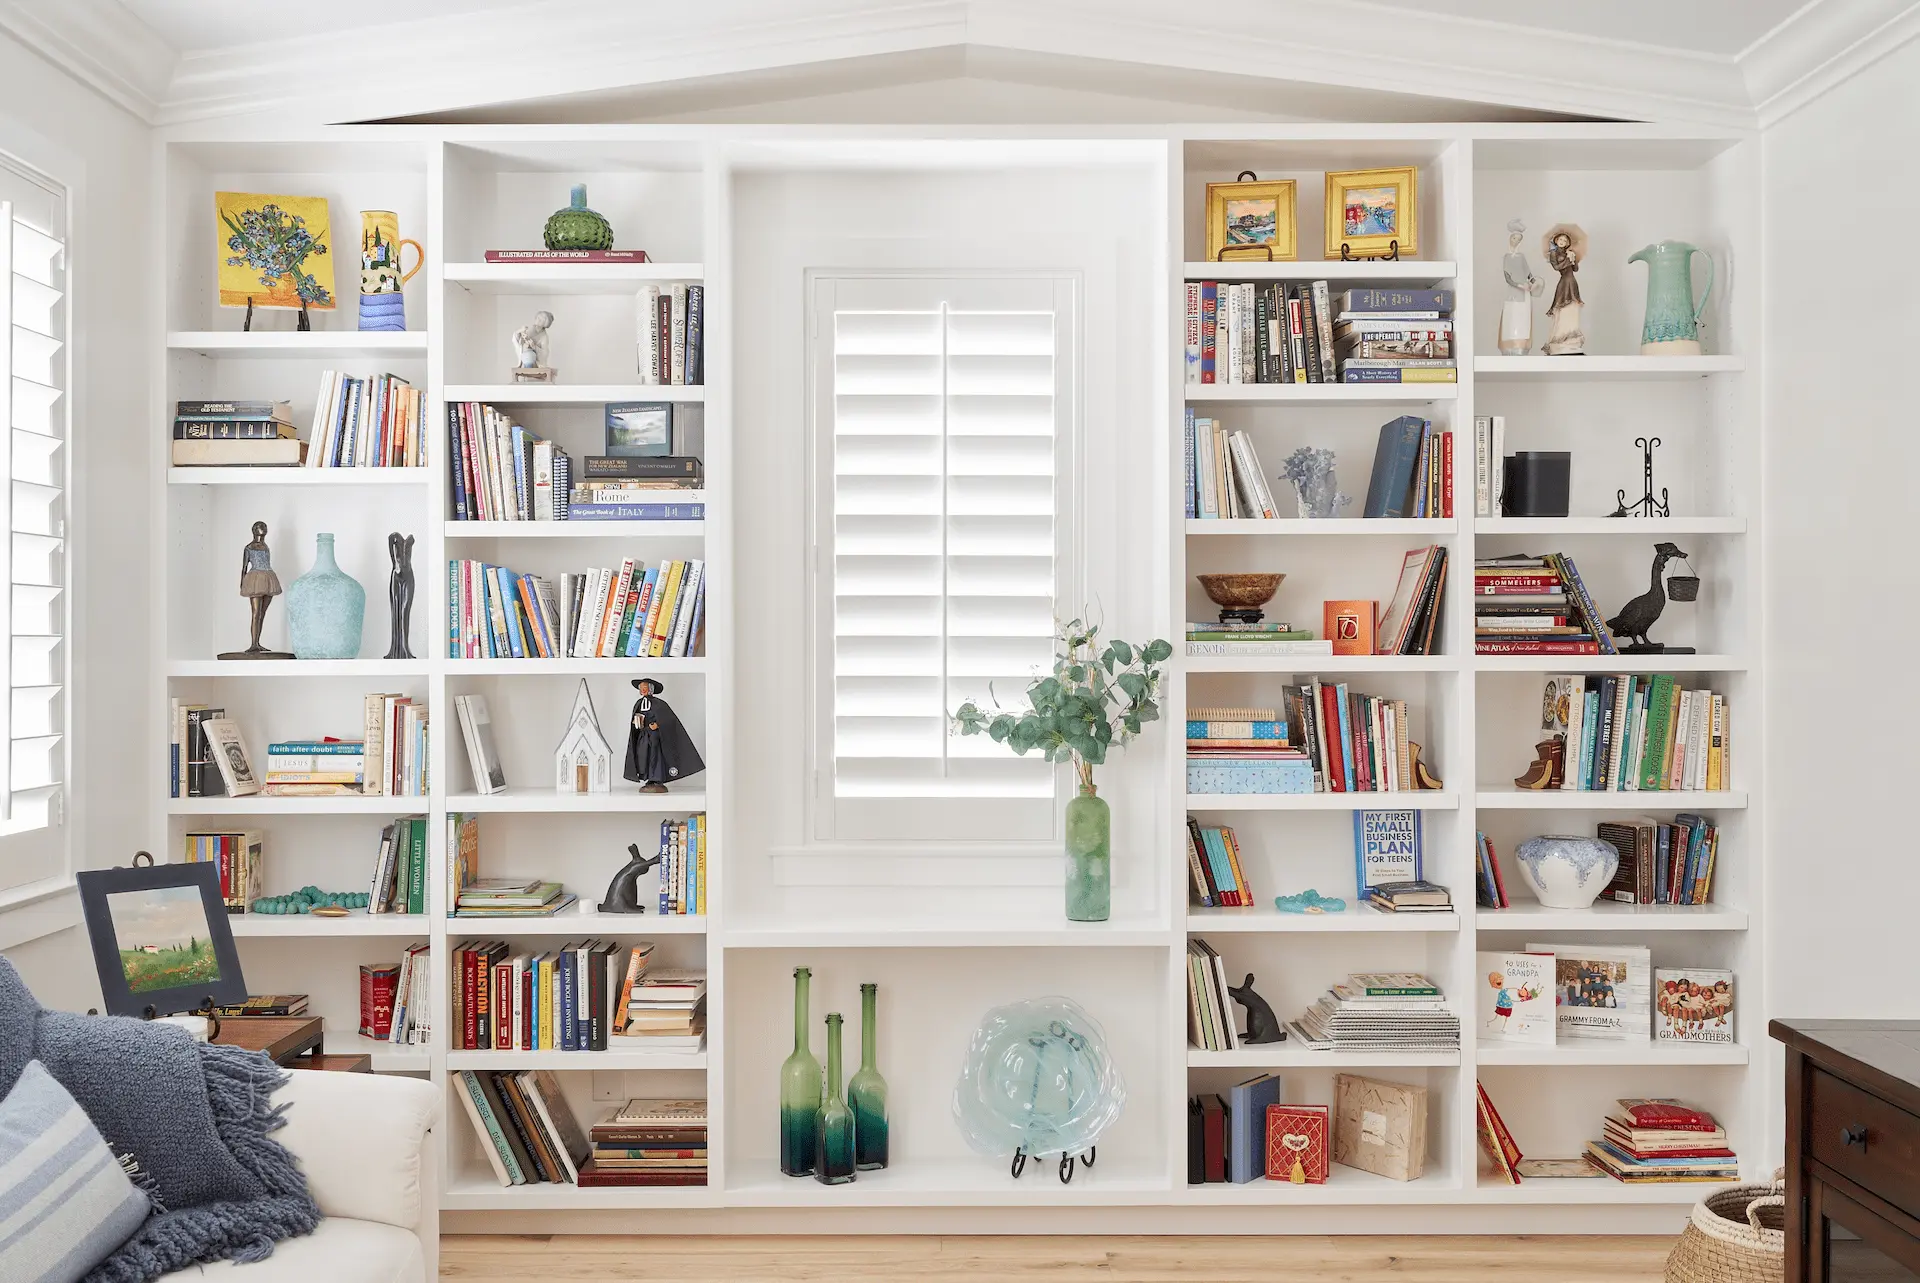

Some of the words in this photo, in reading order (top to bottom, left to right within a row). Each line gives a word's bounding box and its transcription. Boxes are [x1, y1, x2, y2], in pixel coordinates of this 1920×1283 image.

[692, 287, 701, 312] HARPER
[1207, 300, 1215, 317] TOM
[690, 313, 699, 324] LEE
[1258, 304, 1266, 331] EMERALD
[1207, 319, 1215, 353] BROKAW
[1322, 322, 1331, 360] TRANSITIONS
[469, 439, 479, 473] LONDON
[595, 490, 629, 502] Rome
[617, 507, 644, 516] ITALY
[623, 564, 632, 574] THE
[450, 569, 458, 604] DREAMS
[599, 570, 609, 596] GETTING
[618, 574, 630, 596] CAPTAIN
[596, 596, 605, 611] PAST
[615, 596, 625, 614] CLASS
[640, 584, 652, 612] SWITCH
[595, 612, 602, 621] NO
[647, 594, 661, 626] LIMITLESS
[1581, 592, 1592, 610] SCIENCE
[1592, 616, 1605, 636] WINE
[642, 628, 652, 645] MIND
[1190, 644, 1225, 654] RENOIR
[1511, 643, 1516, 652] of
[1661, 679, 1672, 690] the
[1658, 692, 1669, 717] world's
[1572, 703, 1580, 741] OTTOLENGHI
[1604, 710, 1612, 723] MILK
[1691, 705, 1700, 735] DEFINED
[1602, 724, 1611, 745] STREET
[1653, 719, 1667, 752] healthiest
[272, 745, 290, 753] faith
[291, 745, 308, 753] after
[311, 745, 333, 753] doubt
[1355, 732, 1363, 773] THANKSGIVING
[1570, 743, 1578, 764] SIMPLE
[1690, 736, 1698, 754] DISH
[1650, 754, 1663, 775] foods
[1365, 813, 1382, 821] MY
[1385, 813, 1412, 821] FIRST
[1366, 821, 1412, 833] SMALL
[1366, 833, 1413, 841] BUSINESS
[414, 839, 422, 865] LITTLE
[1367, 841, 1413, 855] PLAN
[1367, 855, 1385, 863] FOR
[1388, 855, 1413, 863] TEENS
[413, 866, 421, 895] WOMEN
[1506, 967, 1539, 978] GRANDPA
[1515, 960, 1528, 968] USES
[477, 955, 488, 1014] TRACTION
[225, 1007, 243, 1016] Lugs!
[1559, 1015, 1589, 1024] GRAMMY
[1589, 1016, 1608, 1025] FROM
[1659, 1030, 1731, 1042] GRANDMOTHERS
[464, 1072, 474, 1084] DEL
[492, 1132, 503, 1143] DEL
